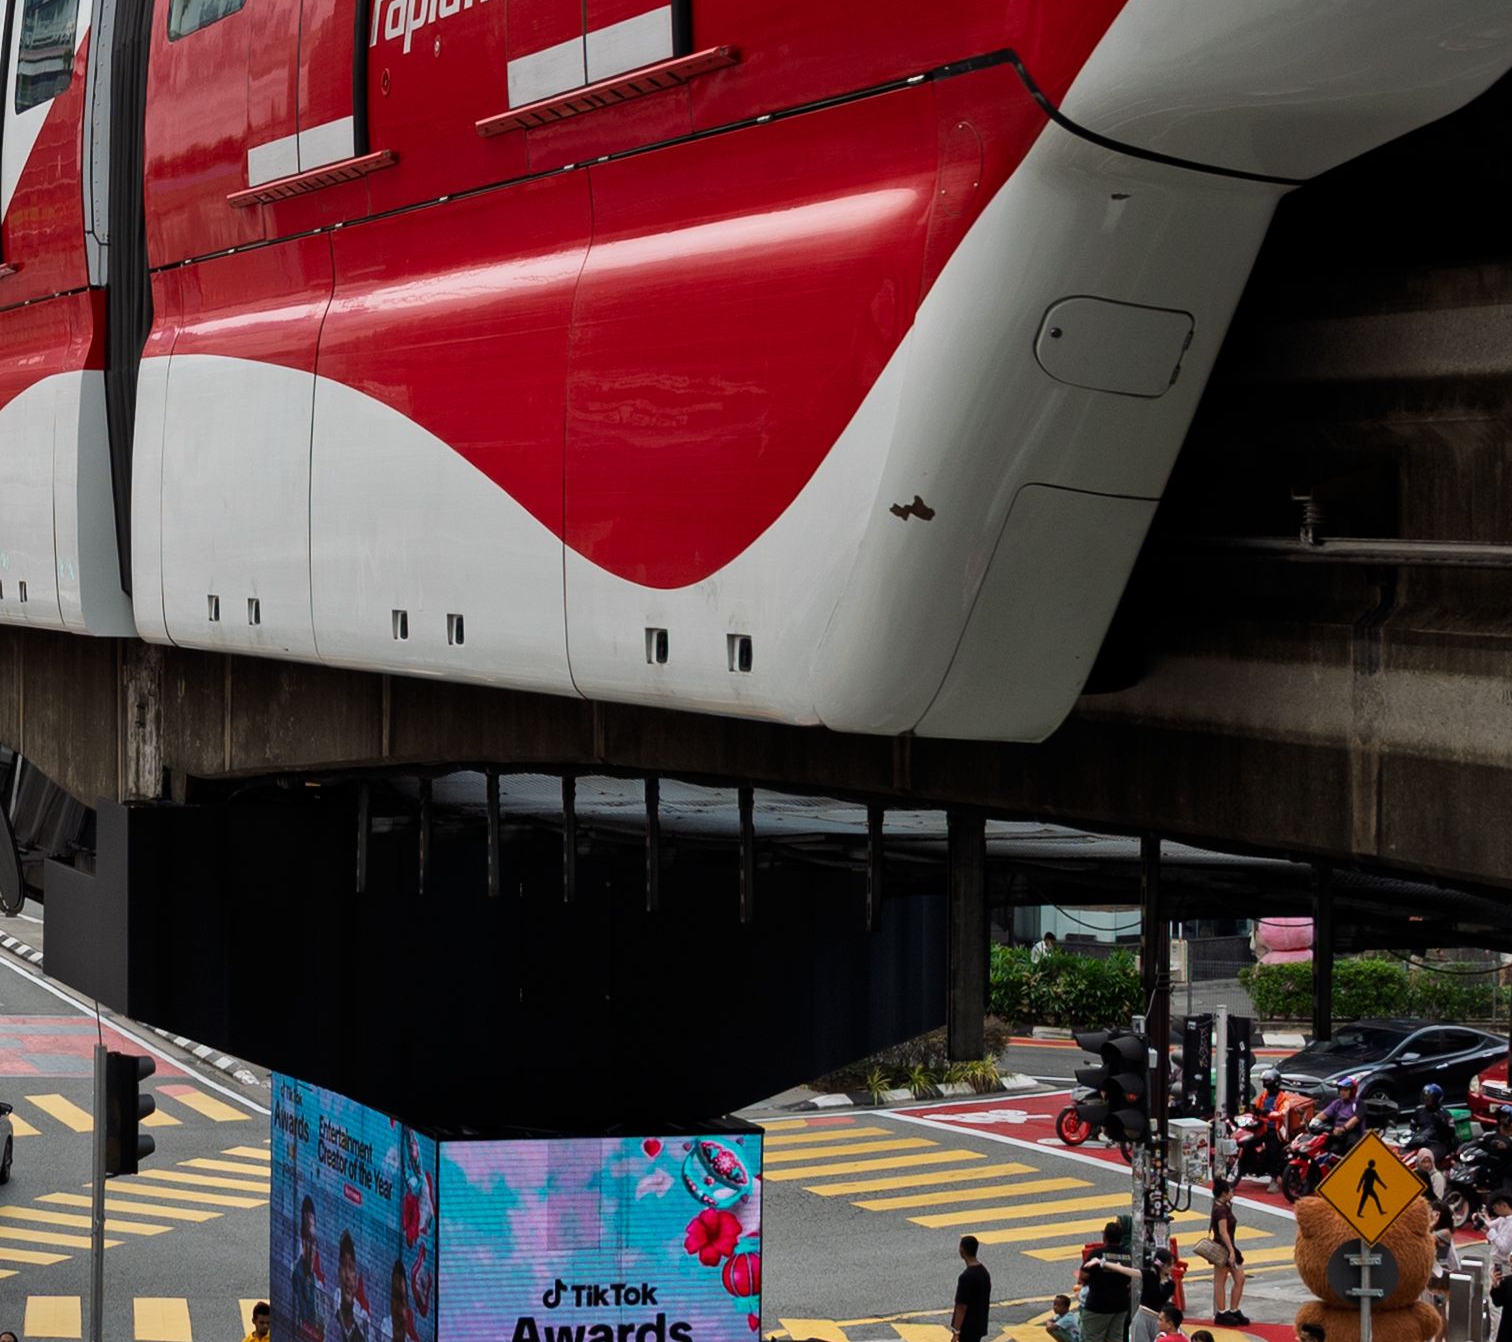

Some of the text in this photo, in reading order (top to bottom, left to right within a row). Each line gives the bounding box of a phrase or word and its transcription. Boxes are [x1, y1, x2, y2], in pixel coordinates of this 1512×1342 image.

[274, 1100, 310, 1143] Awards
[318, 1114, 374, 1164] Entertainment
[317, 1139, 393, 1201] Creator of the Year
[571, 1283, 658, 1308] TikTok
